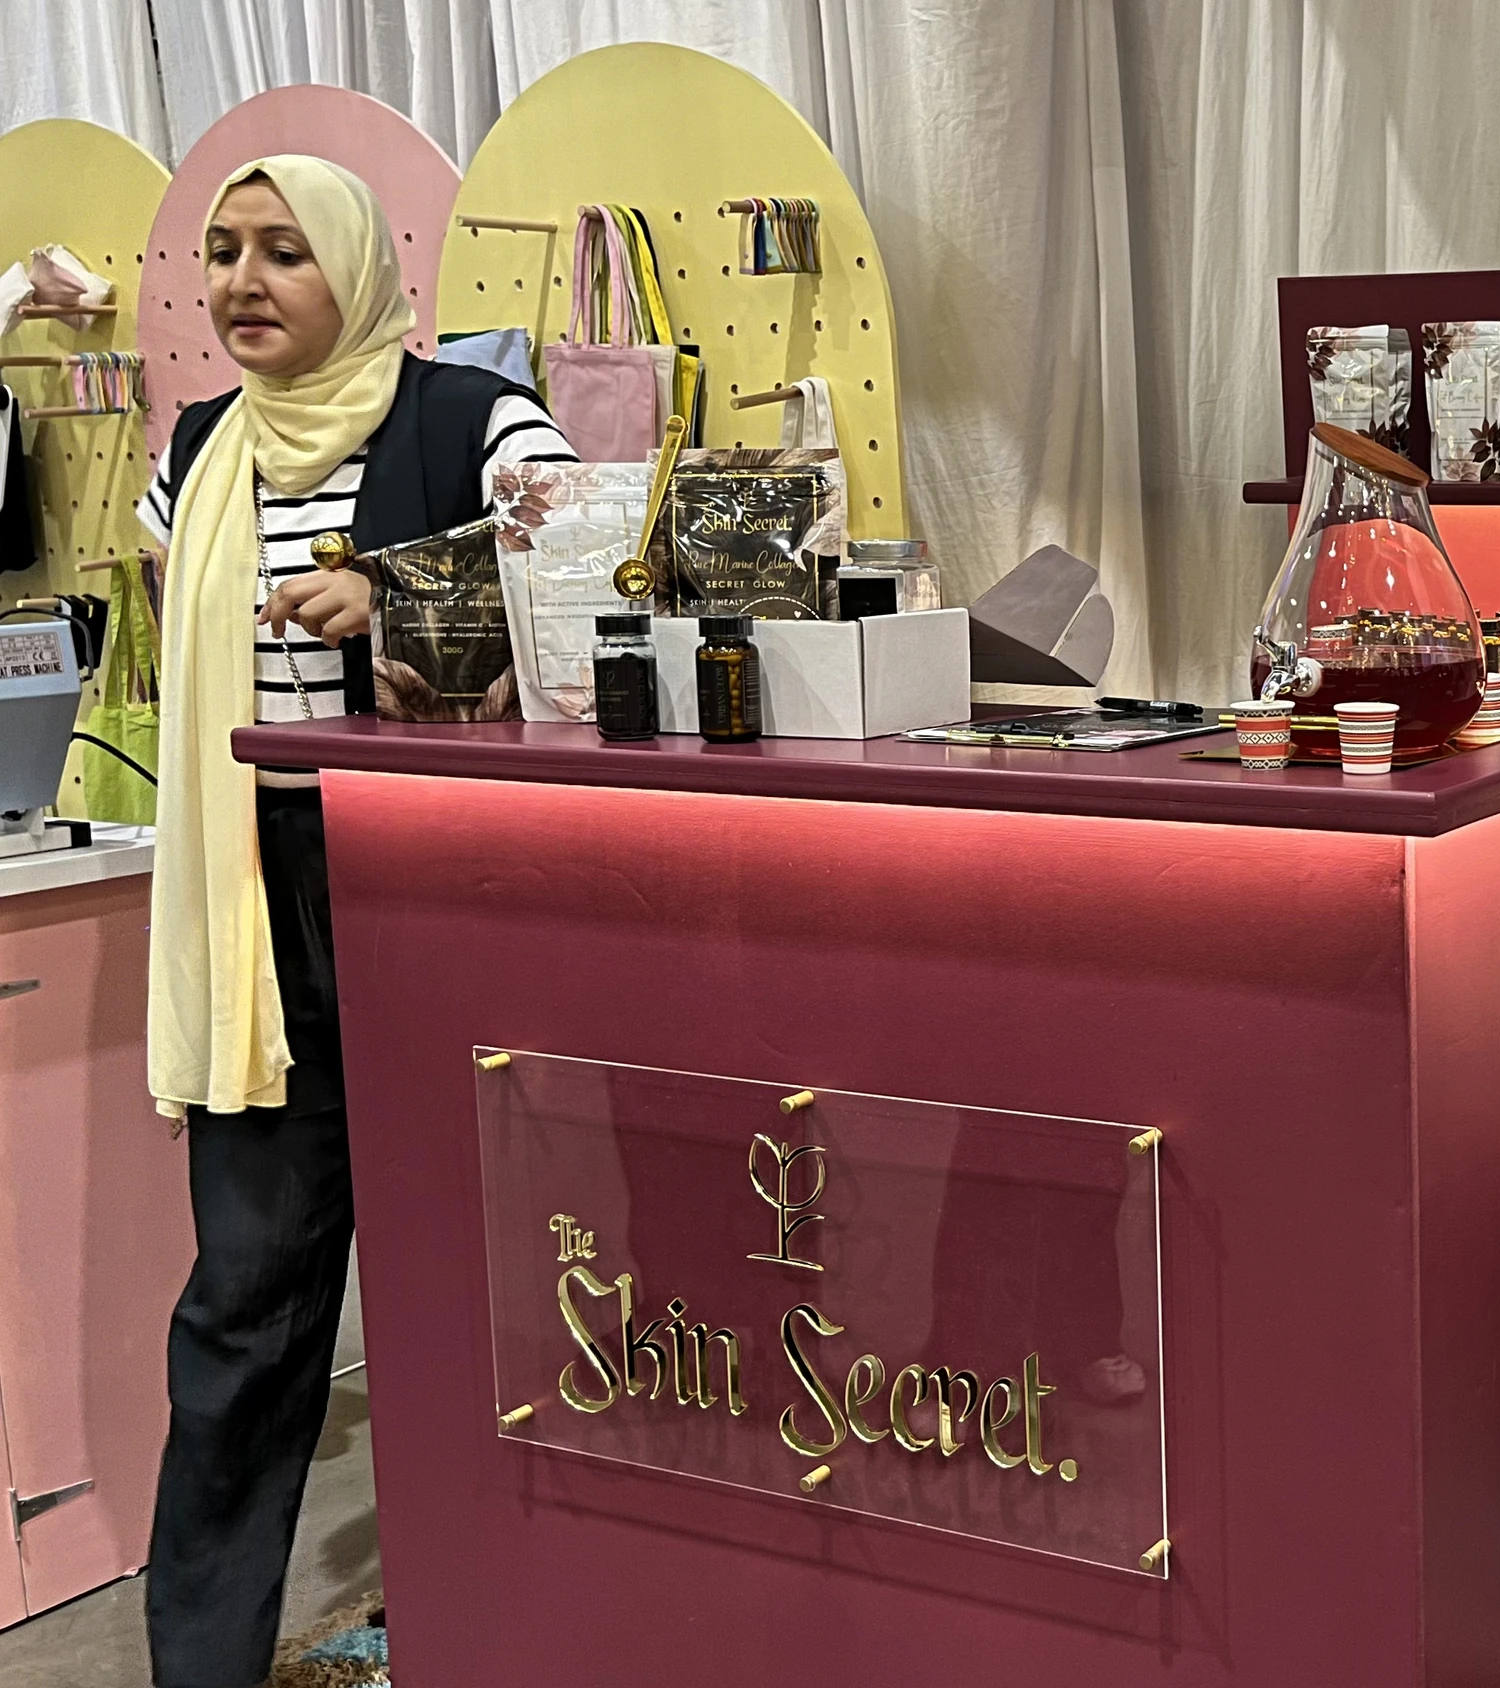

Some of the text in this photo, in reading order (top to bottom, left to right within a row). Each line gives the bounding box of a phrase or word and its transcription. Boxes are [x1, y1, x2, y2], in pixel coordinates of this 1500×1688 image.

[702, 512, 793, 534] Skin Secret.
[463, 552, 498, 577] Collag
[710, 549, 754, 574] Marine
[411, 581, 491, 591] SECRET GLOW
[706, 580, 786, 589] SECRET GLOW
[689, 599, 746, 608] SKIN HEALT
[11, 664, 32, 677] PRESS
[34, 662, 63, 675] MACHINE
[549, 1213, 598, 1262] The
[558, 1265, 1081, 1481] Skin Secret.
